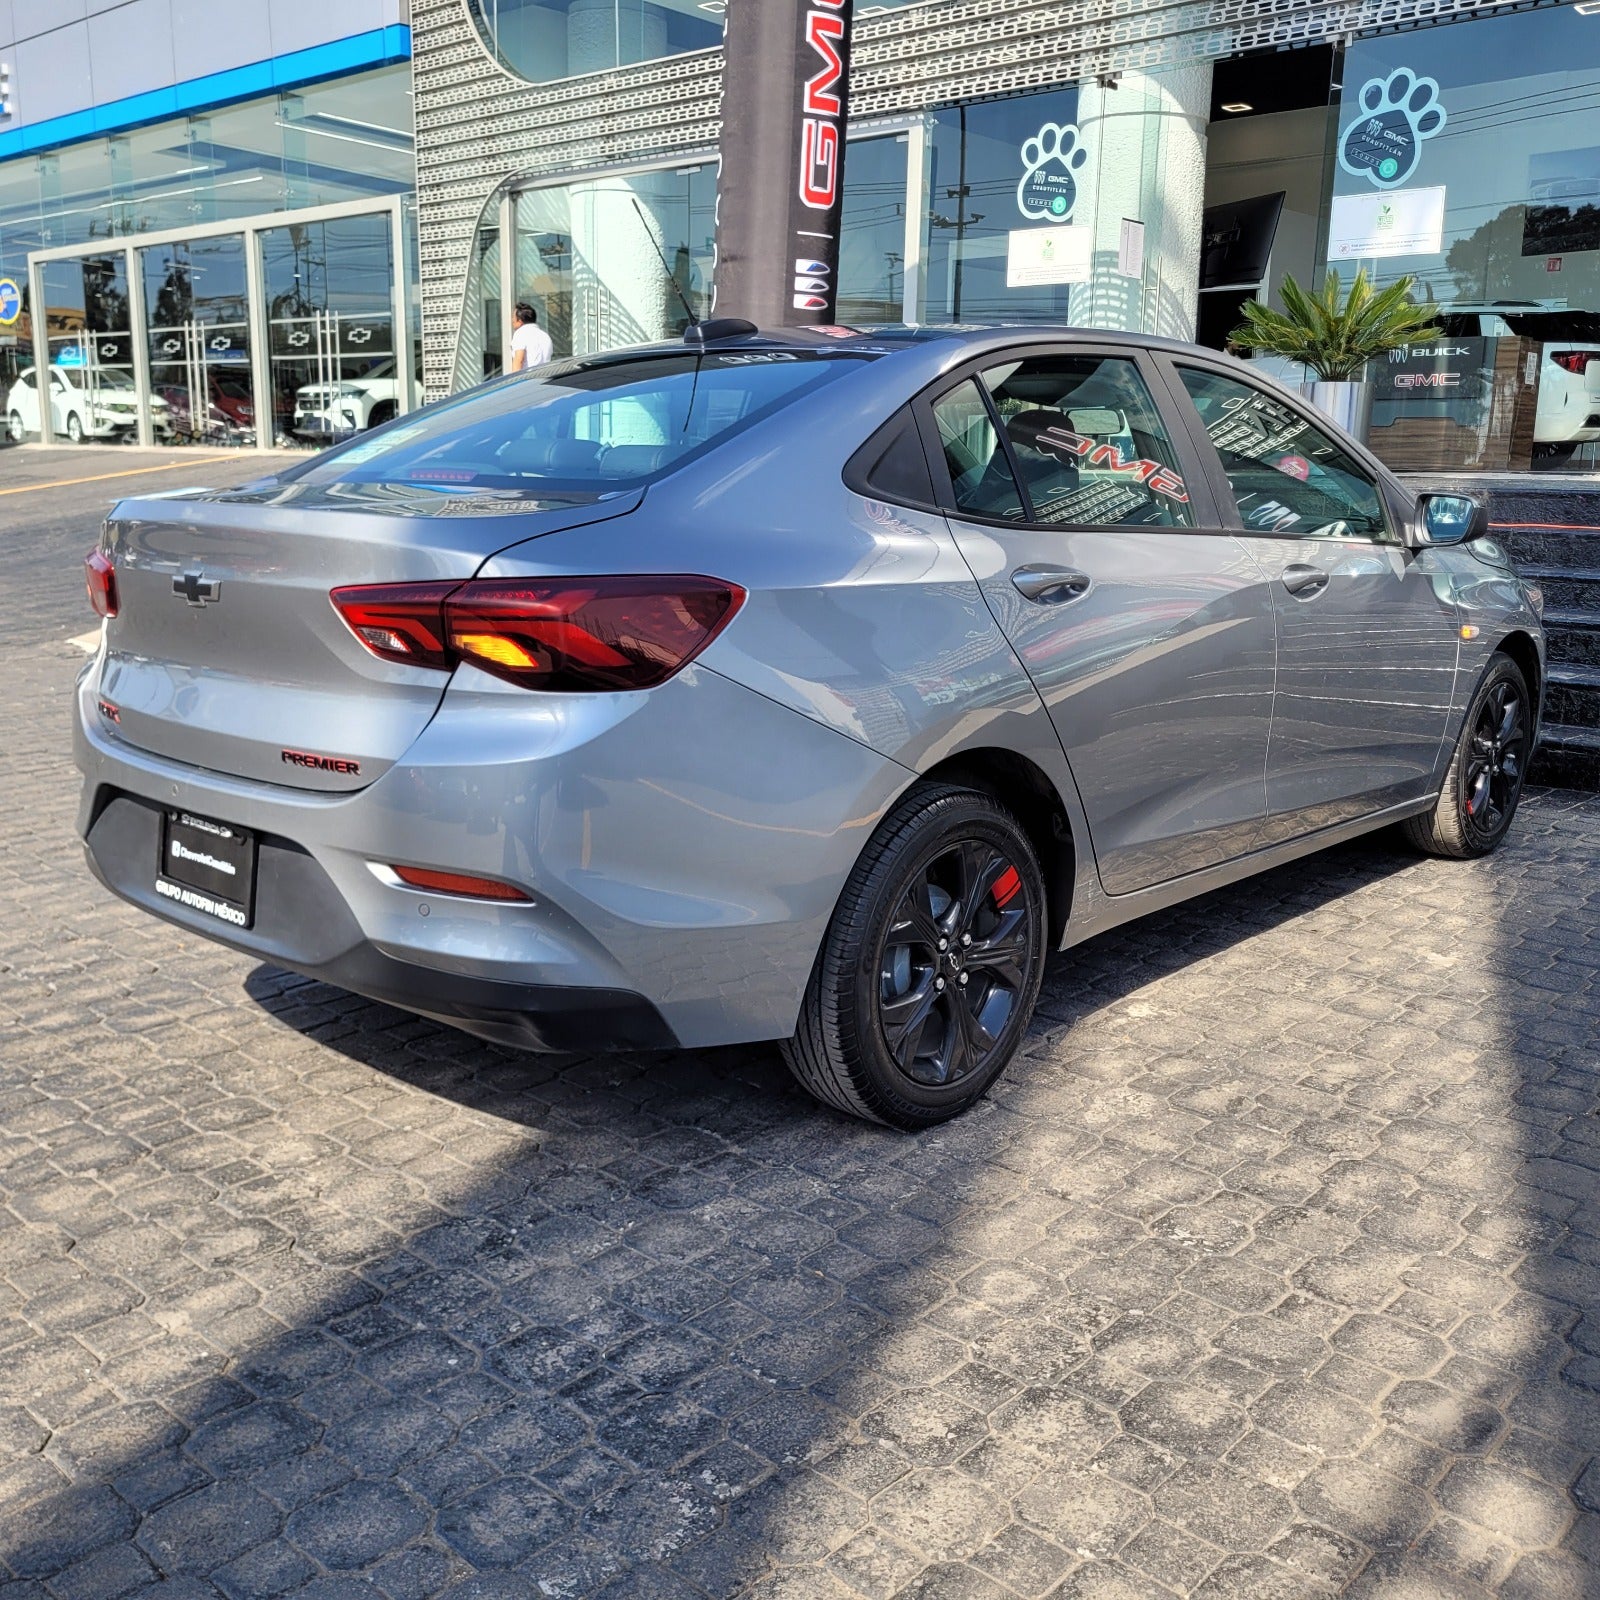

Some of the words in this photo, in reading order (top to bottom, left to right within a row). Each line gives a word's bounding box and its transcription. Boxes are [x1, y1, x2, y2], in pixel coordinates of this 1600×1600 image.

[799, 0, 845, 209] GM
[1384, 130, 1409, 146] GMC
[1353, 151, 1380, 166] SOMOS
[1048, 175, 1069, 184] GMC
[1412, 347, 1471, 357] BUICK
[1394, 373, 1460, 388] GMC
[281, 748, 361, 776] PREMIER
[155, 879, 182, 900] GRUPO
[181, 890, 214, 914] AUTOFIN
[214, 902, 246, 926] MÉXICO
